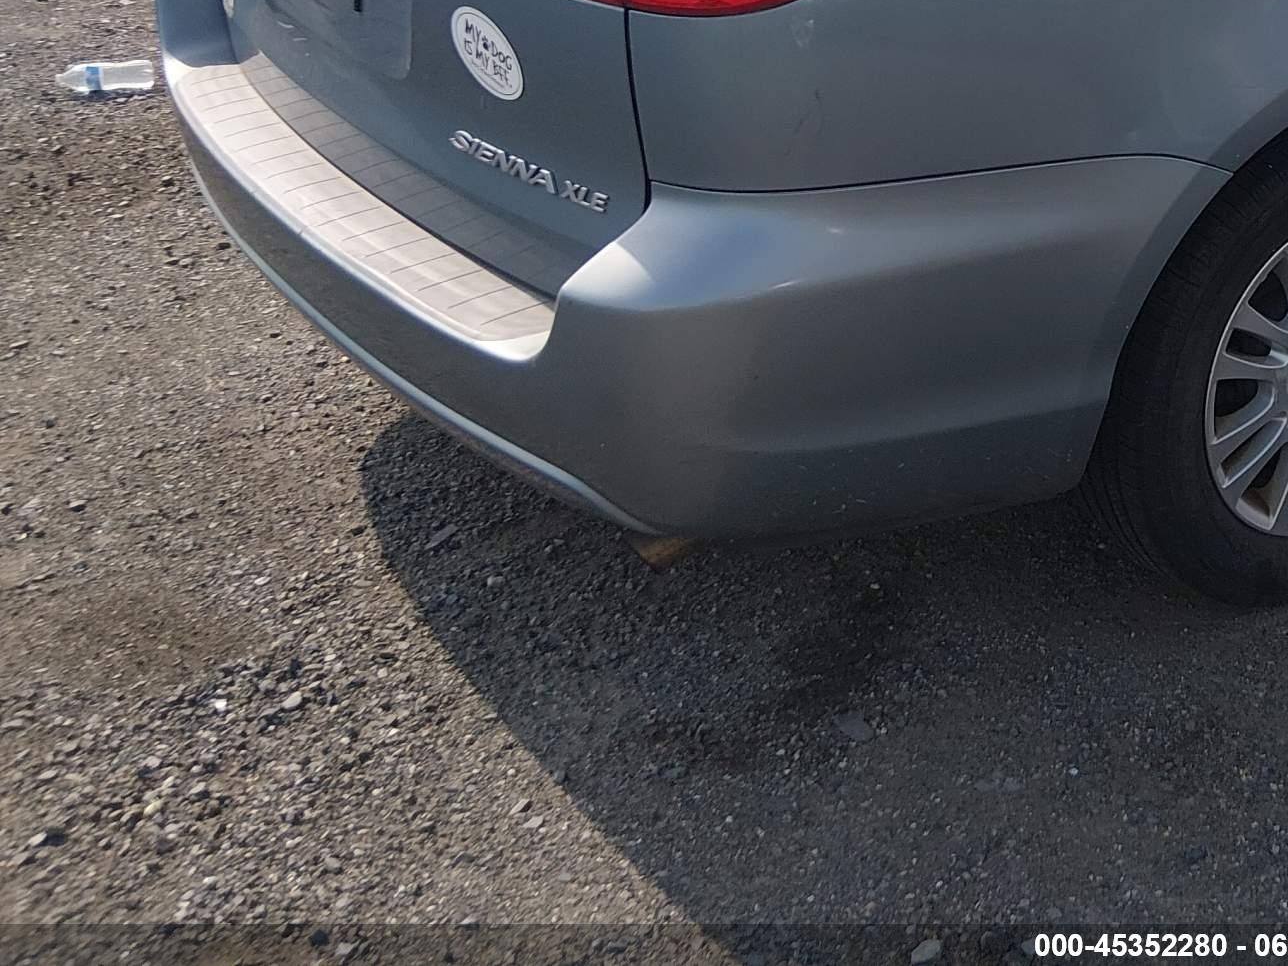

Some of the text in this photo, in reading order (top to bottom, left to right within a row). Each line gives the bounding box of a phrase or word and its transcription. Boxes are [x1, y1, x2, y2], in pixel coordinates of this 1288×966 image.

[465, 18, 512, 71] MY DOG
[448, 130, 611, 214] SIENNA XLE
